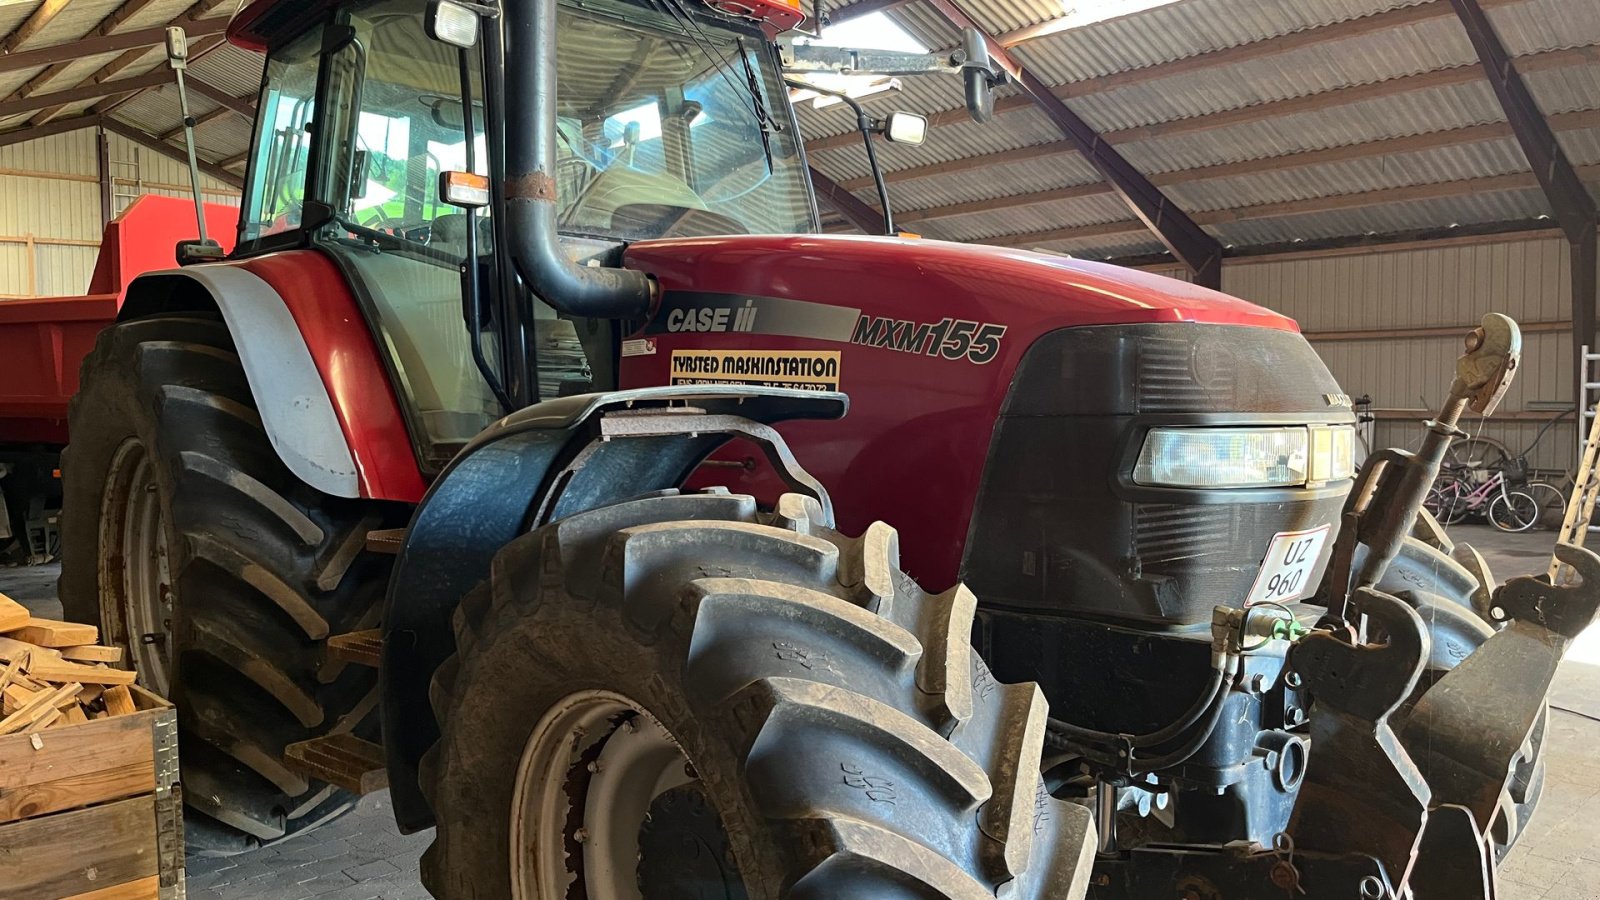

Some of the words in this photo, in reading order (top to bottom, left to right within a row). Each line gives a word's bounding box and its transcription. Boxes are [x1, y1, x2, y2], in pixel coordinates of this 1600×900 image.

[667, 308, 731, 332] CASE
[851, 314, 1008, 365] MXM155
[673, 356, 720, 374] TYRSTED
[722, 356, 837, 377] MASKINSTATION
[1284, 538, 1313, 566] UZ
[1265, 569, 1303, 599] 960
